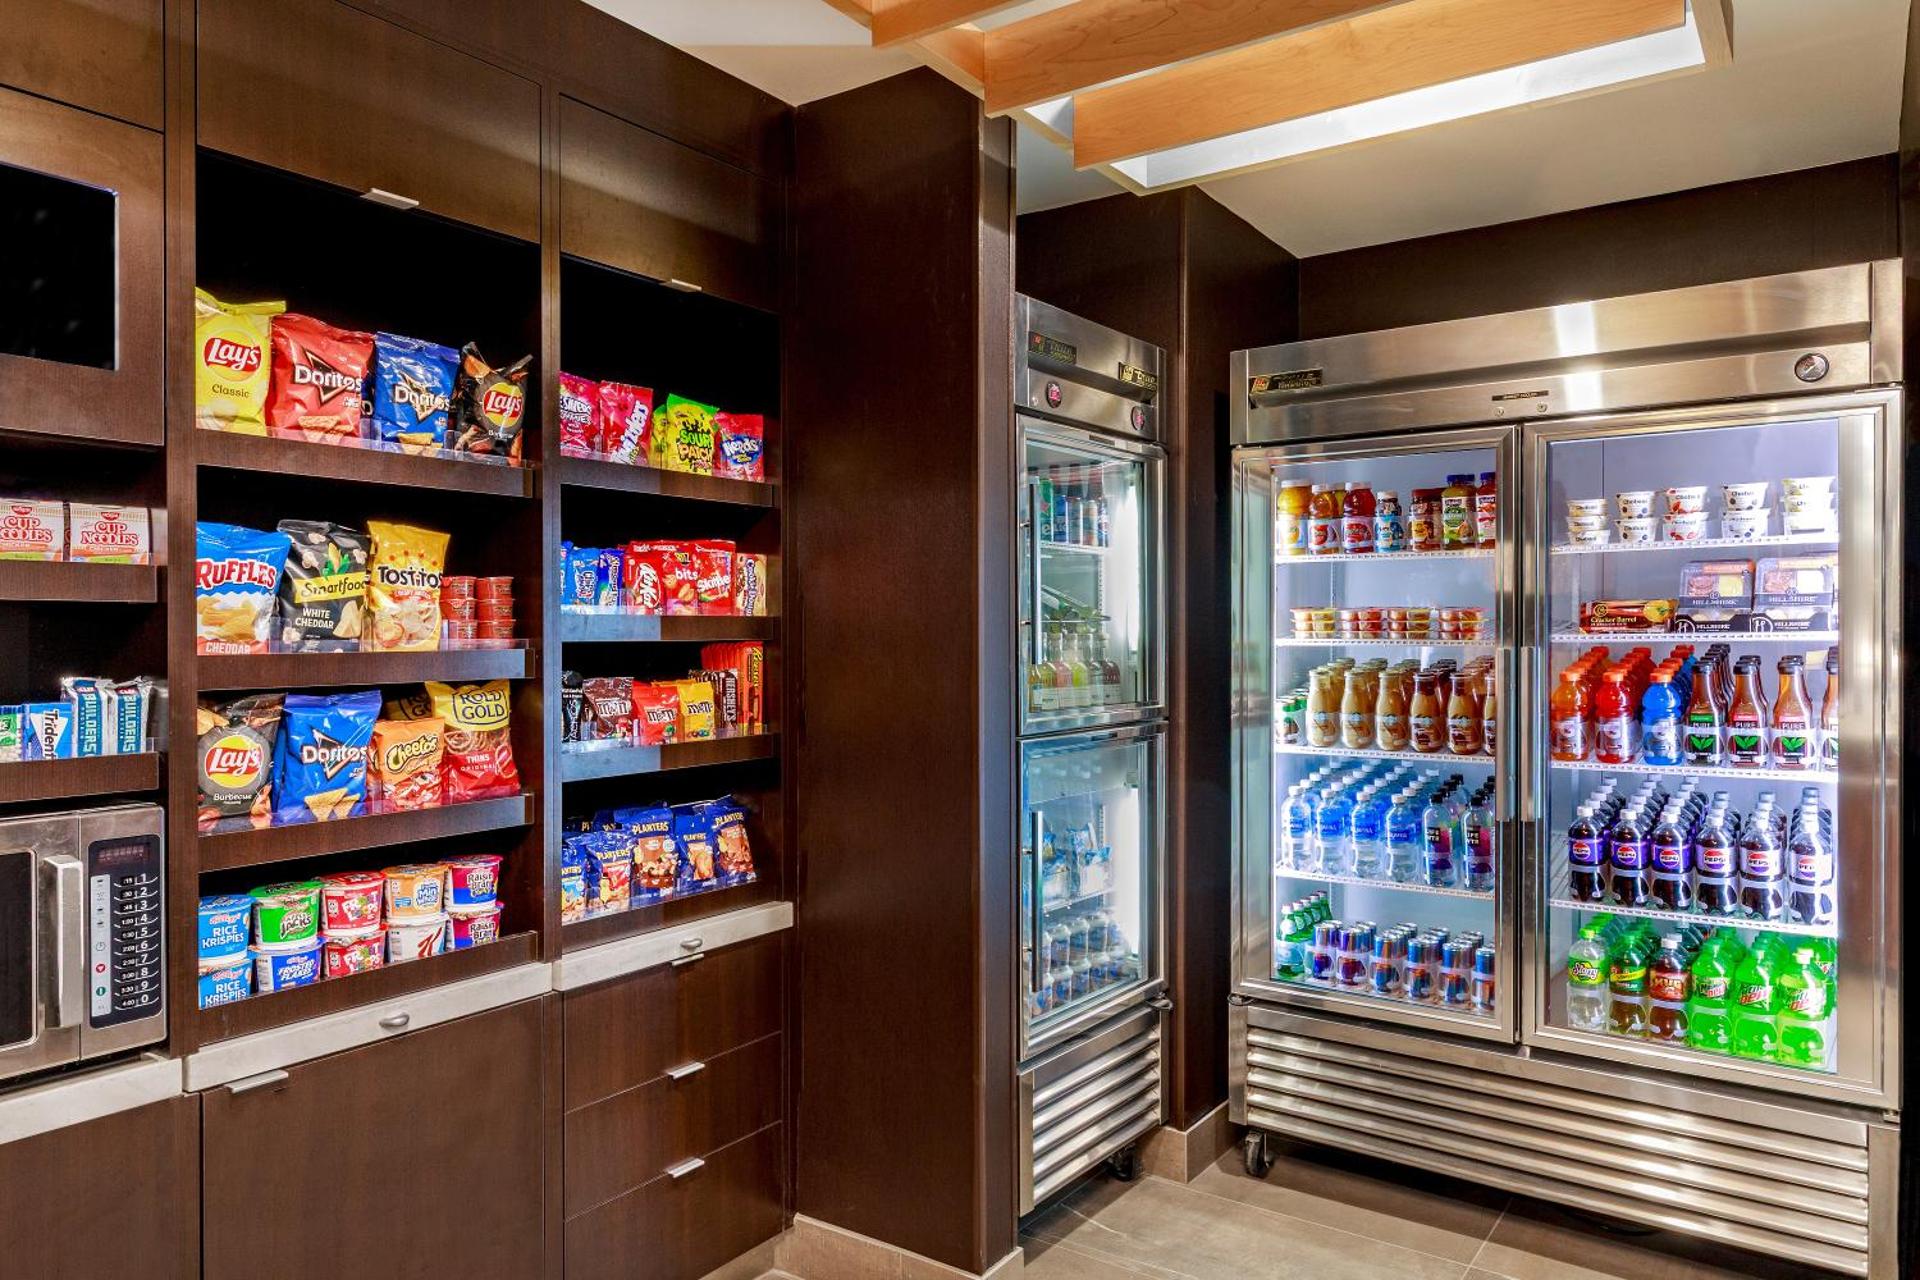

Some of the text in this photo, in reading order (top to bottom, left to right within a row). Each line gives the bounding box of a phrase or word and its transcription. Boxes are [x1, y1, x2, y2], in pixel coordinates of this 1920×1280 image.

[206, 337, 259, 371] Lay's
[294, 364, 363, 394] Doritos
[211, 383, 250, 399] Classic
[395, 385, 451, 411] Doritos
[486, 393, 522, 415] Lay's
[679, 428, 713, 449] SOUR
[4, 516, 41, 530] CUP
[94, 521, 128, 534] CUP
[81, 531, 139, 546] NOODLES
[196, 559, 277, 589] RUFFLES
[675, 567, 699, 581] bits
[302, 607, 331, 619] WHITE
[295, 618, 334, 630] CHEDDAR
[205, 642, 251, 655] CHEDDAR
[460, 690, 502, 705] ROLD
[461, 705, 505, 719] GOLD
[82, 693, 97, 754] BUILDERS
[122, 694, 137, 753] BUILDERS
[1782, 722, 1806, 730] PURE
[43, 708, 59, 760] Trident
[302, 745, 368, 764] Doritos
[386, 735, 438, 773] Cheetos
[465, 753, 490, 764] THINS
[209, 745, 262, 777] Lay's
[213, 792, 252, 801] Barbecue
[632, 822, 670, 834] PLANTERS
[140, 873, 147, 883] 1
[468, 872, 493, 882] Raisin
[140, 887, 148, 896] 2
[140, 900, 148, 910] 3
[140, 913, 148, 923] 4
[141, 927, 148, 935] 5
[212, 925, 239, 937] RICE
[470, 922, 495, 933] Raisin
[141, 941, 148, 949] 6
[202, 933, 245, 949] KRISPIES
[141, 953, 148, 964] 7
[141, 967, 148, 976] 8
[141, 980, 149, 990] 9
[215, 980, 241, 994] RICE
[141, 993, 149, 1003] 0
[205, 989, 247, 1004] KRISPIES
